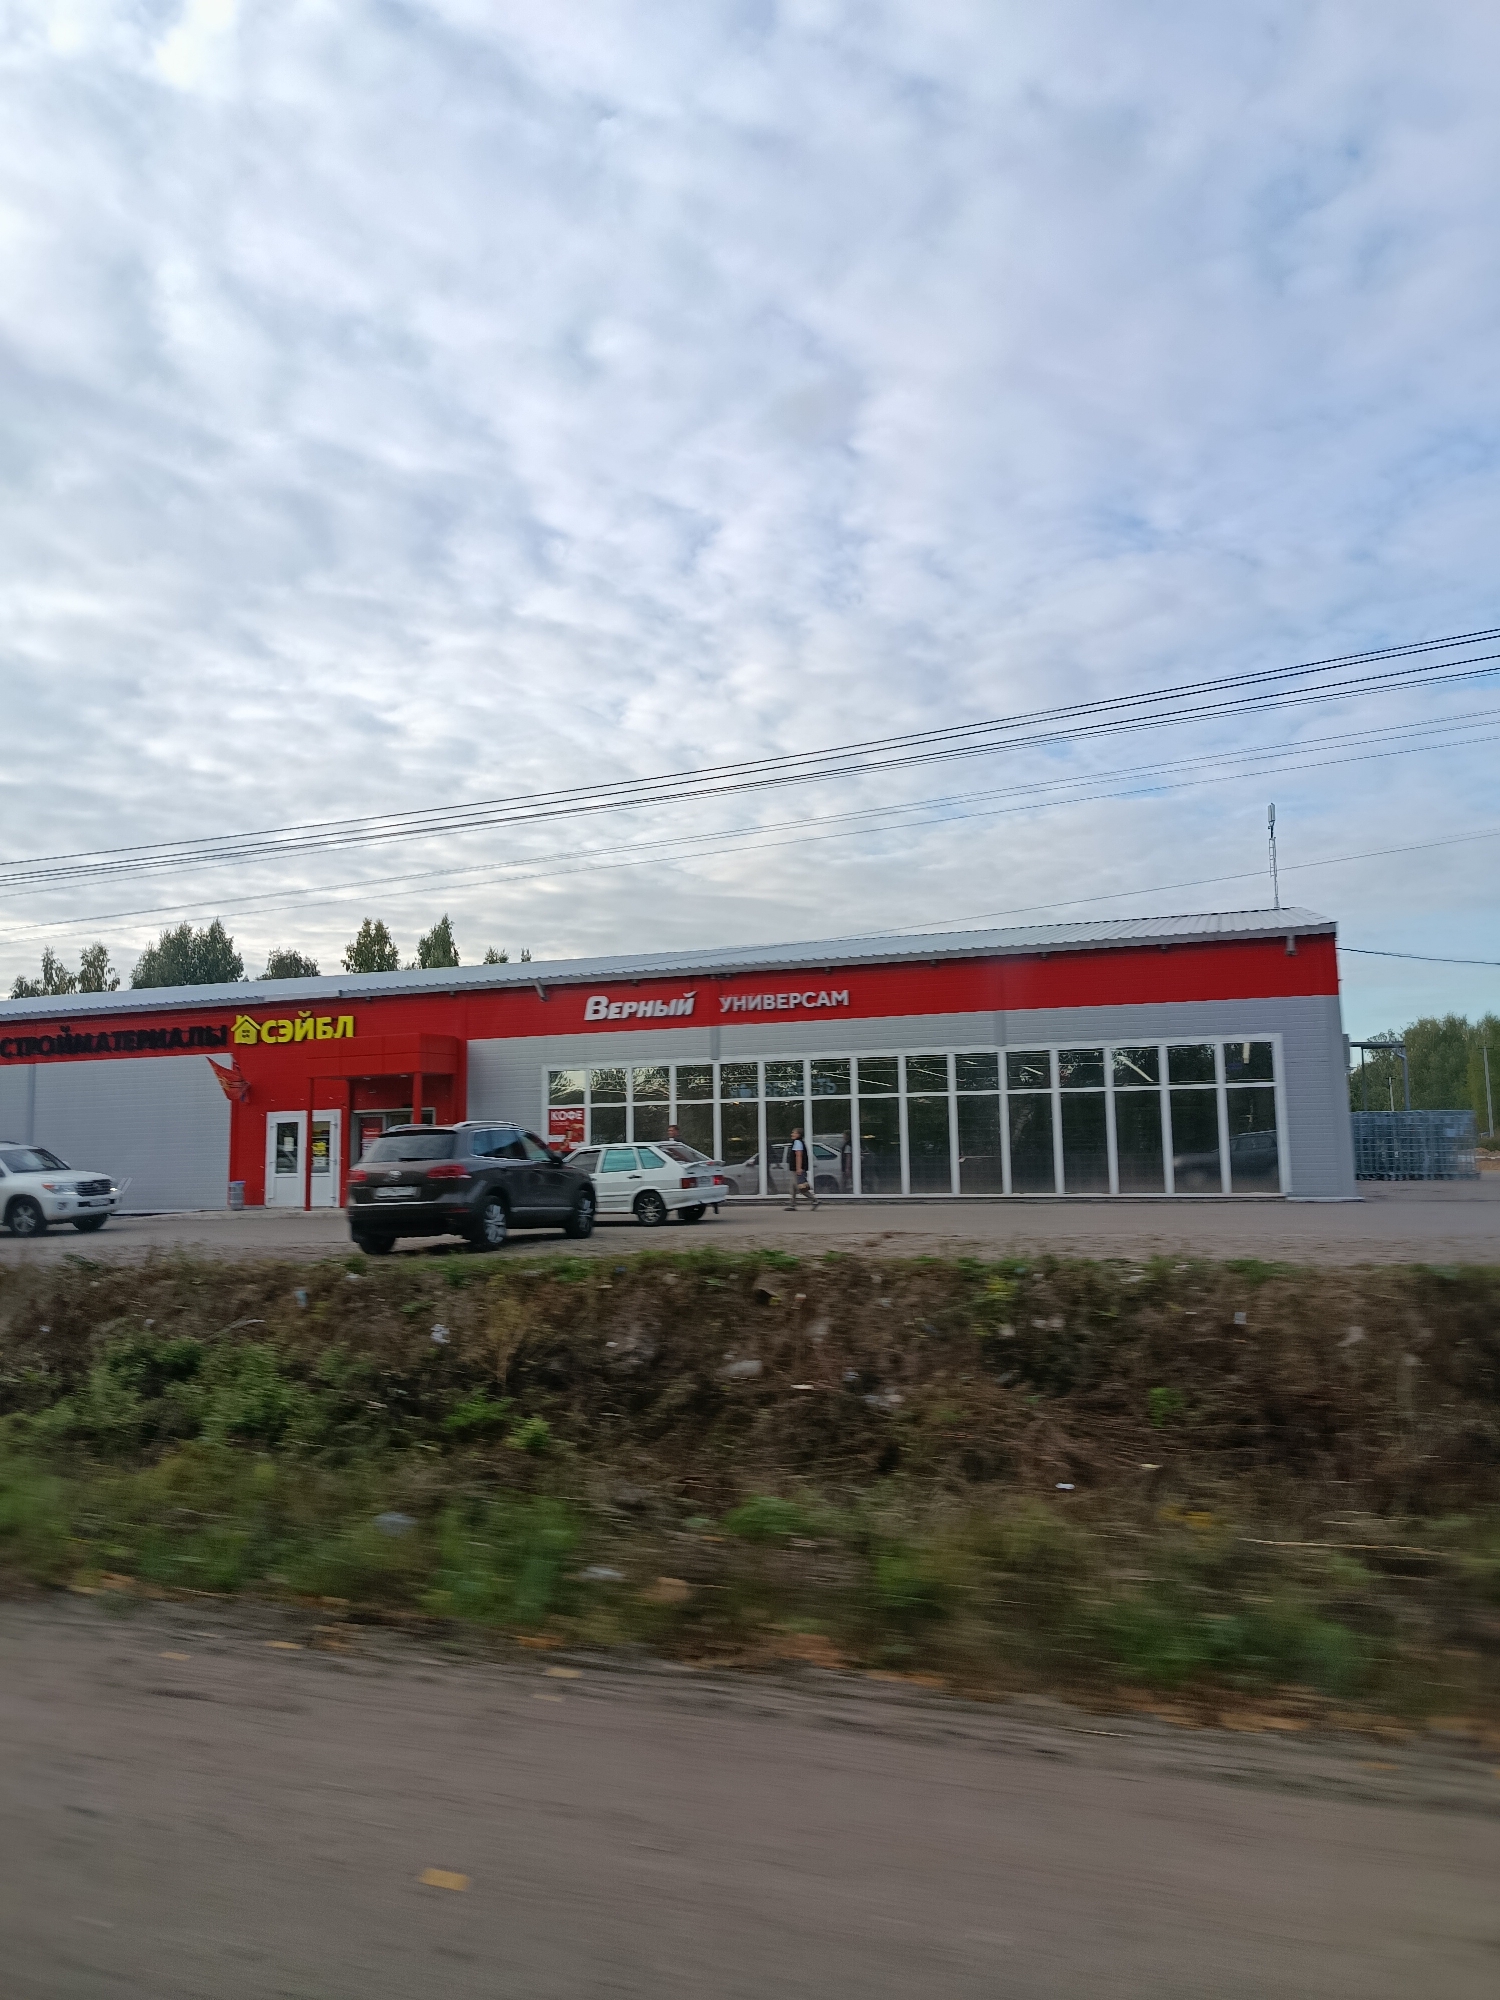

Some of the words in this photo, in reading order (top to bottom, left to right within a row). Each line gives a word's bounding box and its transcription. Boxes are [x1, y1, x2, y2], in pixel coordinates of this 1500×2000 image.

[719, 990, 849, 1012] УНИВЕРСАМ
[260, 1010, 355, 1044] СЭЙБЛ
[0, 1025, 228, 1058] СТРОЙМАТЕРИАЛЫ
[550, 1110, 583, 1120] КОФЕ
